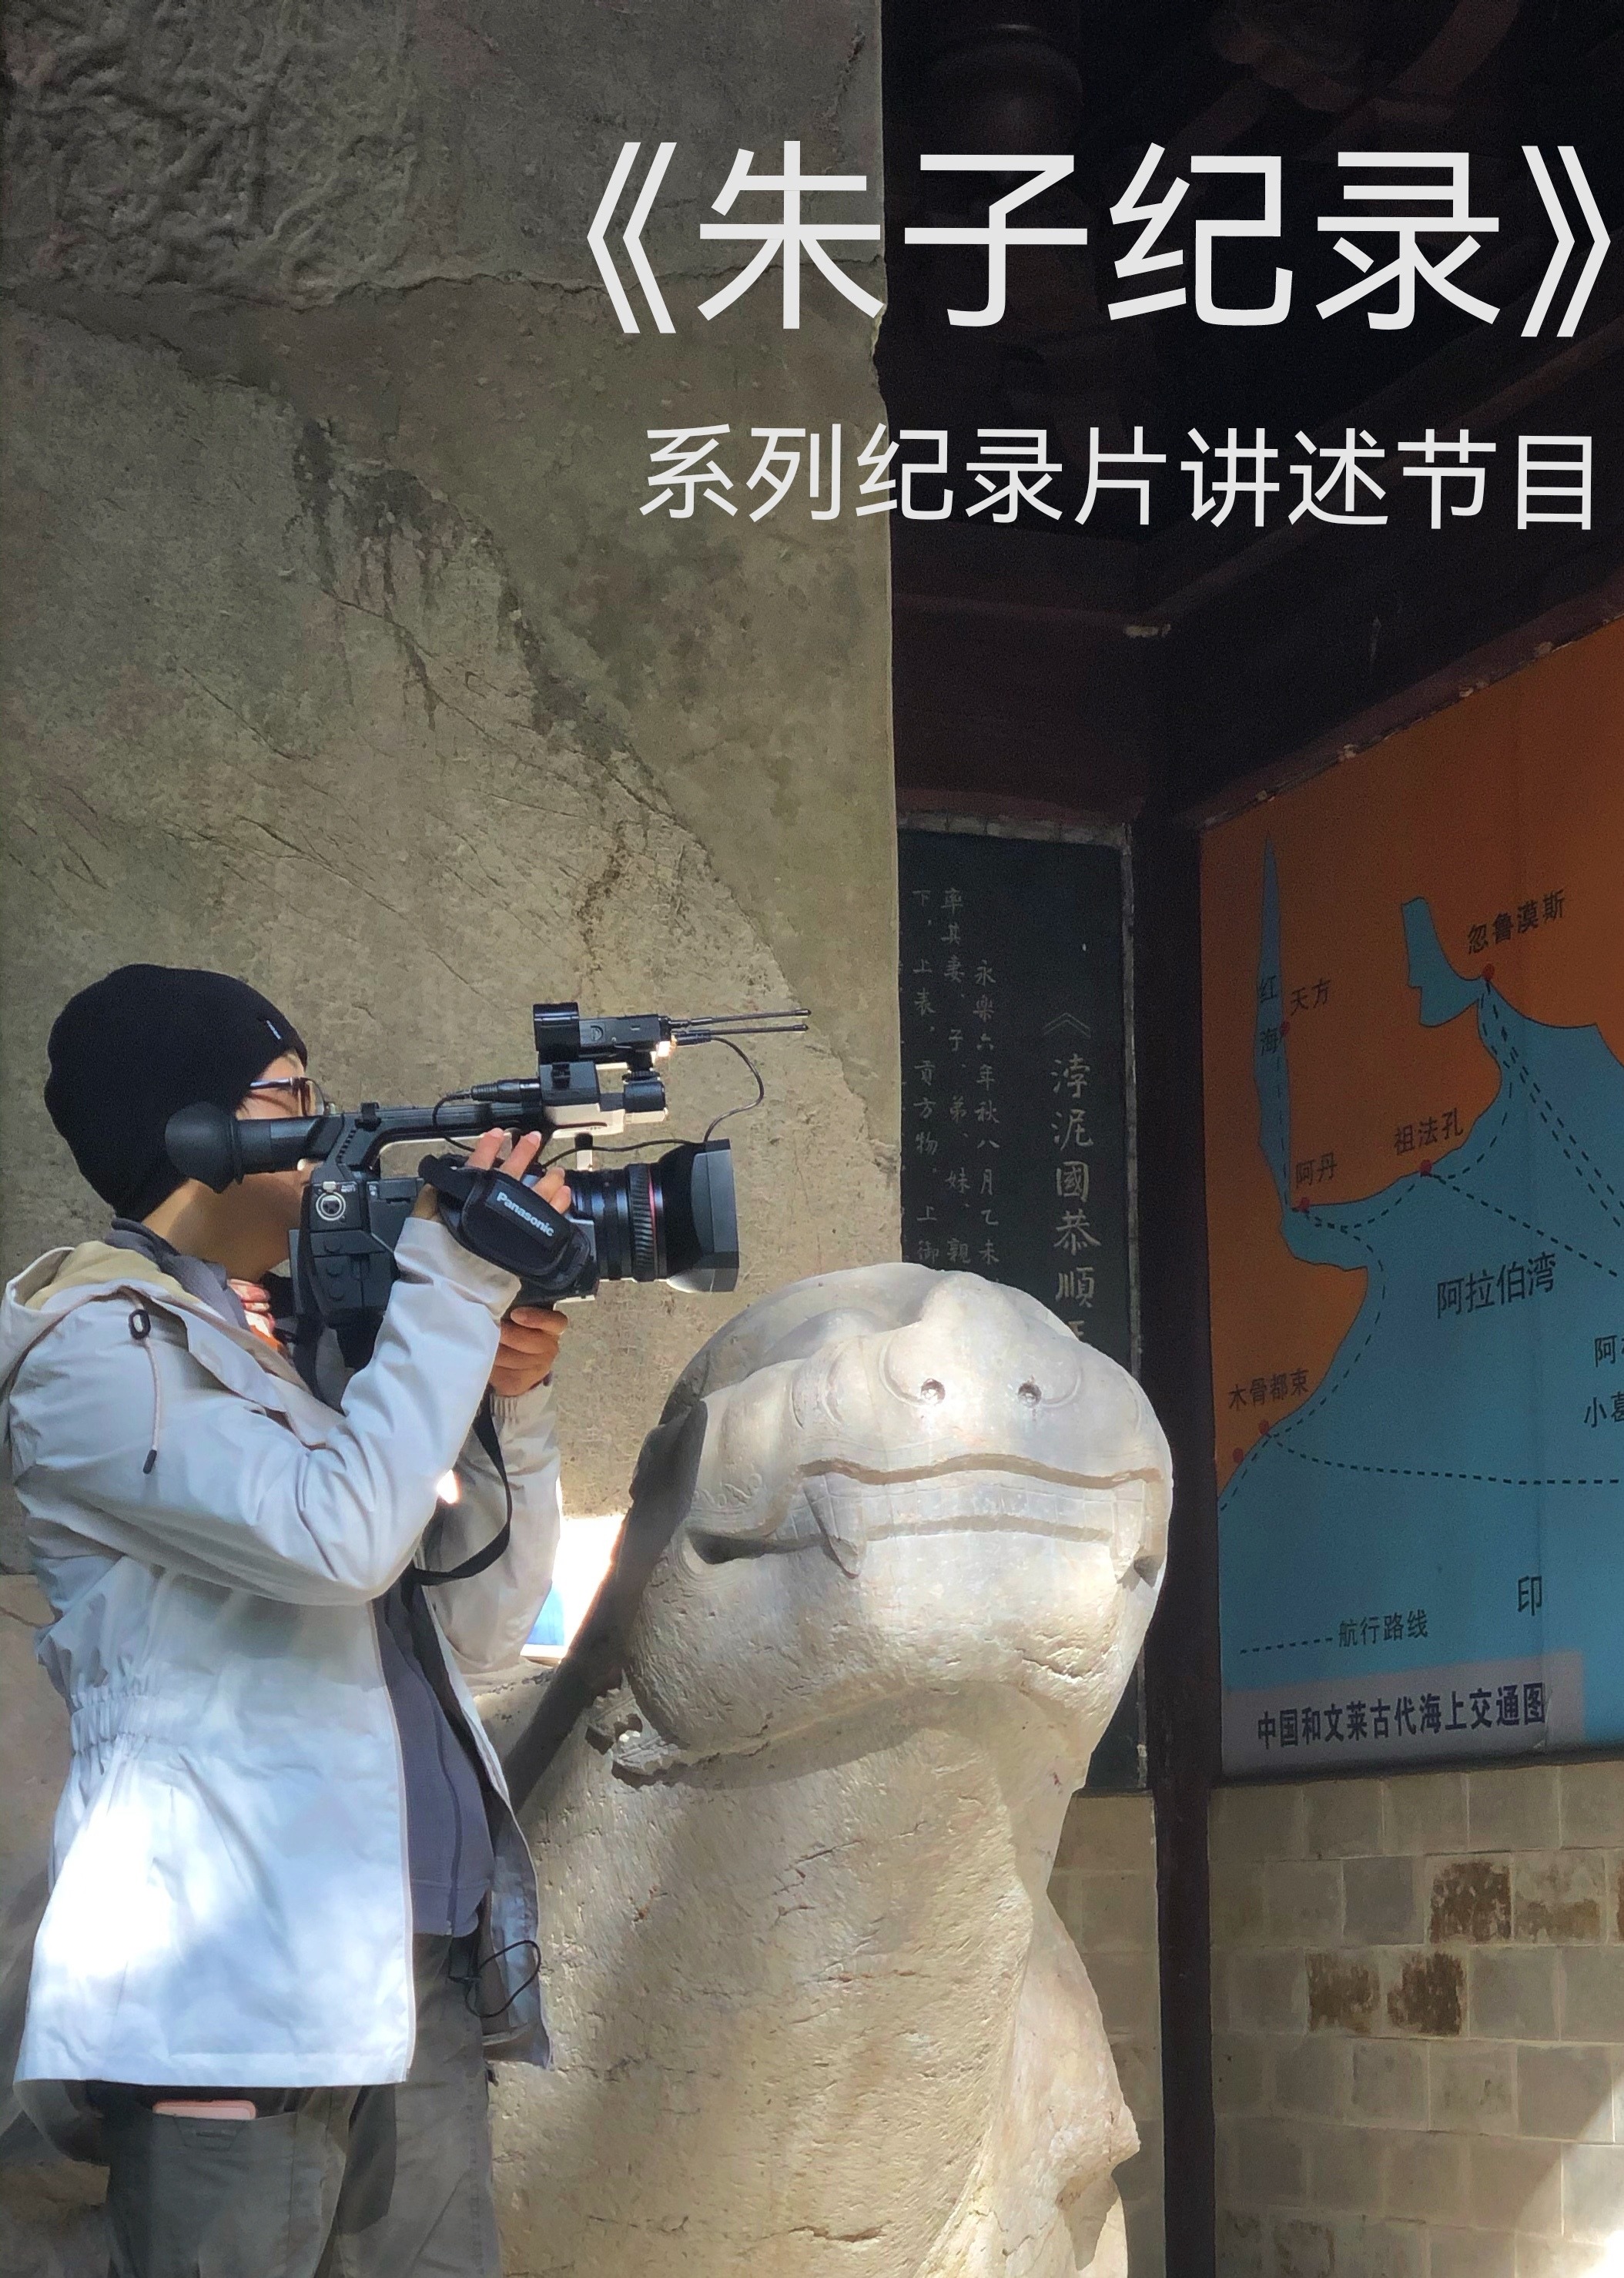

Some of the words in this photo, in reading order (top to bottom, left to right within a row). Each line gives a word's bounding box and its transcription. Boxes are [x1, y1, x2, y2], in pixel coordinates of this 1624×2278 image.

[1291, 978, 1331, 1017] 天方
[1295, 1152, 1338, 1189] 阿丹
[497, 1192, 554, 1237] Panasonic
[1437, 1251, 1556, 1319] 阿拉伯湾
[1594, 1335, 1624, 1368] 阿
[1517, 1575, 1542, 1616] 印
[1338, 1609, 1428, 1647] 航行路线
[1257, 1682, 1545, 1750] 中国和文莱古代海上交通图
